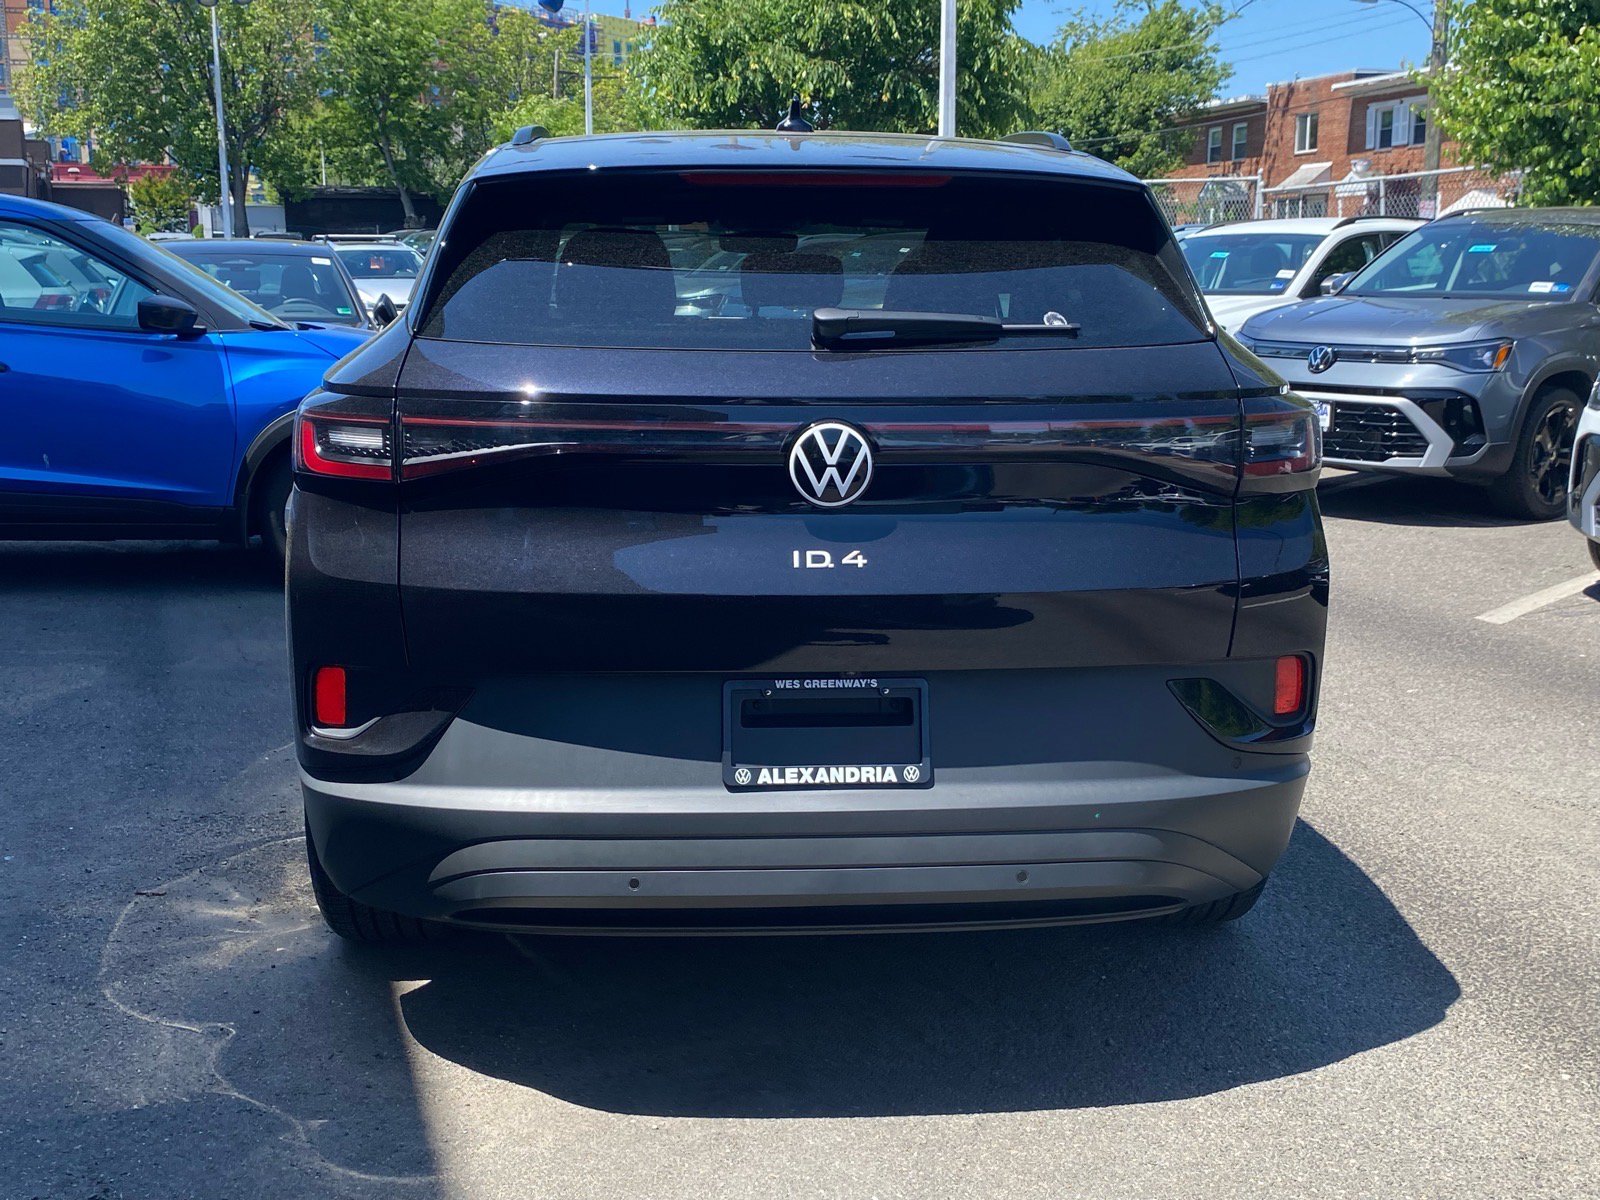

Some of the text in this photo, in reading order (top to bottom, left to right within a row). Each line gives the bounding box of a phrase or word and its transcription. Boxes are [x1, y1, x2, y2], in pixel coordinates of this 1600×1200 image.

[789, 422, 873, 507] VW
[775, 678, 878, 689] WES GREENWAY'S
[757, 766, 898, 785] ALEXANDRIA
